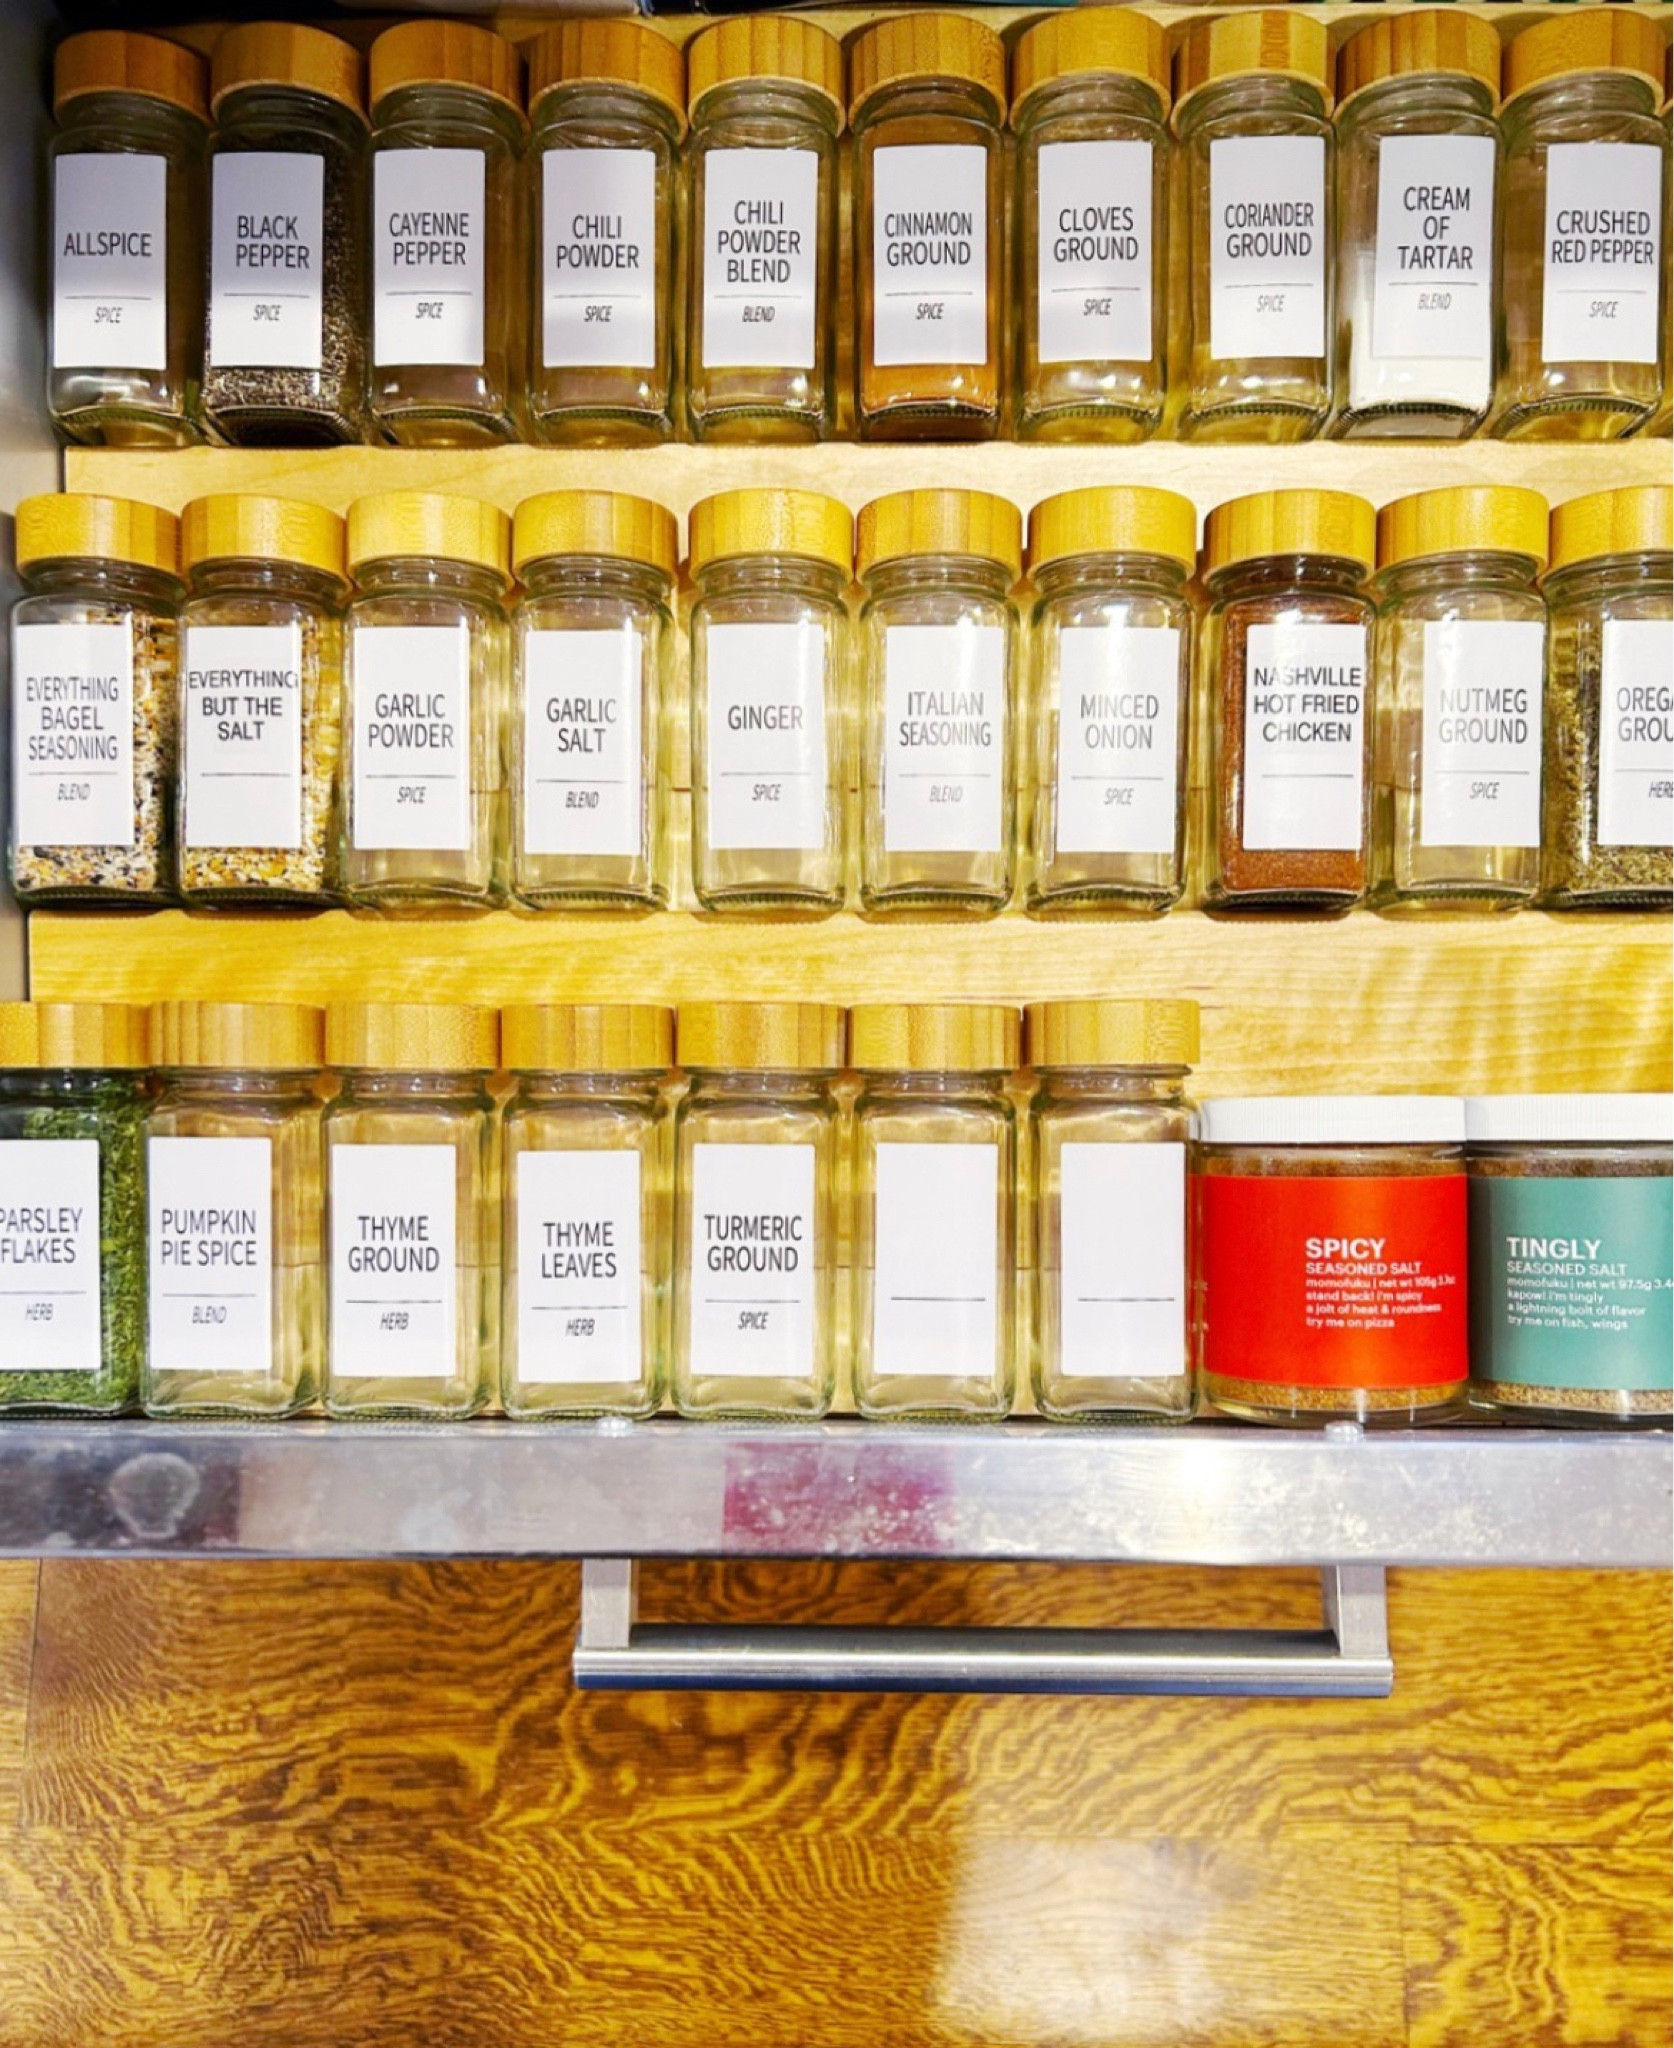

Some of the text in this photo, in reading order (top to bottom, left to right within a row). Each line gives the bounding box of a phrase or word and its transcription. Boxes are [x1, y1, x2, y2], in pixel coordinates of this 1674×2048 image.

[1404, 187, 1470, 211] CREAM
[734, 200, 783, 224] CHILI
[1060, 207, 1133, 232] CLOVES
[1225, 203, 1313, 228] CORIANDER
[1557, 210, 1650, 235] CRUSHED
[237, 216, 297, 239] BLACK
[389, 213, 469, 237] CAYENNE
[572, 215, 621, 239] CHILI
[884, 213, 972, 237] CINNAMON
[1423, 216, 1450, 240] OF
[64, 232, 151, 257] ALLSPICE
[393, 240, 466, 265] PEPPER
[718, 230, 800, 254] POWDER
[887, 240, 970, 266] GROUND
[1053, 236, 1138, 261] GROUND
[1227, 231, 1312, 257] GROUND
[1552, 239, 1653, 264] RED PEPPER
[236, 243, 309, 269] PEPPER
[557, 244, 638, 269] POWDER
[1397, 246, 1472, 269] TARTAR
[728, 259, 790, 282] BLEND
[253, 305, 281, 321] SPICE
[416, 302, 443, 319] SPICE
[916, 303, 944, 320] SPICE
[1083, 298, 1112, 316] SPICE
[1257, 295, 1285, 312] SPICE
[1418, 293, 1452, 310] BLEND
[1589, 301, 1619, 318] SPICE
[94, 307, 122, 323] SPICE
[584, 306, 612, 322] SPICE
[742, 306, 775, 322] BLEND
[1255, 666, 1360, 687] NASHVILLE
[26, 677, 118, 702] EVERYTHING
[1441, 689, 1526, 713] NUTMEG
[203, 698, 282, 717] BUT THE
[376, 694, 445, 718] GARLIC
[546, 698, 615, 722] GARLIC
[908, 691, 983, 717] ITALIAN
[1081, 694, 1159, 719] MINCED
[1254, 694, 1359, 714] HOT FRIED
[42, 706, 104, 730] BAGEL
[728, 705, 803, 730] GINGER
[218, 721, 264, 741] SALT
[369, 723, 453, 748] POWDER
[558, 728, 605, 752] SALT
[899, 721, 991, 746] SEASONING
[1085, 724, 1152, 749] ONION
[1263, 722, 1351, 742] CHICKEN
[1439, 718, 1527, 743] GROUND
[29, 735, 117, 760] SEASONING
[57, 783, 90, 800] BLEND
[397, 787, 426, 804] SPICE
[566, 791, 599, 808] BLEND
[752, 784, 781, 801] SPICE
[929, 785, 962, 802] BLEND
[1104, 788, 1134, 805] SPICE
[1470, 782, 1500, 799] SPICE
[162, 1209, 255, 1234] PUMPKIN
[358, 1216, 428, 1241] THYME
[704, 1215, 802, 1241] TURMERIC
[543, 1221, 613, 1247] THYME
[1, 1238, 76, 1263] FLAKES
[162, 1240, 256, 1266] PIE SPICE
[349, 1247, 439, 1272] GROUND
[708, 1246, 798, 1272] GROUND
[1306, 1238, 1385, 1258] SPICY
[1506, 1237, 1602, 1260] TINGLY
[542, 1253, 616, 1278] LEAVES
[1306, 1262, 1422, 1274] SEASONED SALT
[1507, 1261, 1628, 1276] SEASONED SALT
[1306, 1278, 1370, 1287] momofuku
[1379, 1278, 1397, 1287] net
[1507, 1277, 1568, 1288] momofuku
[1577, 1279, 1597, 1289] net
[1600, 1279, 1615, 1289] wt
[1306, 1291, 1339, 1301] stand
[1396, 1291, 1423, 1303] spicy
[1516, 1301, 1566, 1316] lightning
[1569, 1305, 1593, 1315] bolt
[1596, 1305, 1609, 1315] of
[1612, 1305, 1646, 1316] flavor
[1570, 1291, 1603, 1304] tingly
[27, 1303, 53, 1320] HERB
[192, 1306, 226, 1324] BLEND
[381, 1313, 409, 1330] HERB
[738, 1311, 768, 1329] SPICE
[1316, 1304, 1335, 1316] jolt
[1337, 1304, 1350, 1314] of
[1352, 1304, 1379, 1314] heat
[567, 1319, 595, 1336] HERB
[1306, 1317, 1395, 1329] try me on pizza
[1508, 1315, 1521, 1326] try
[1525, 1316, 1542, 1325] me
[1544, 1317, 1560, 1327] on
[1592, 1318, 1628, 1332] wings
